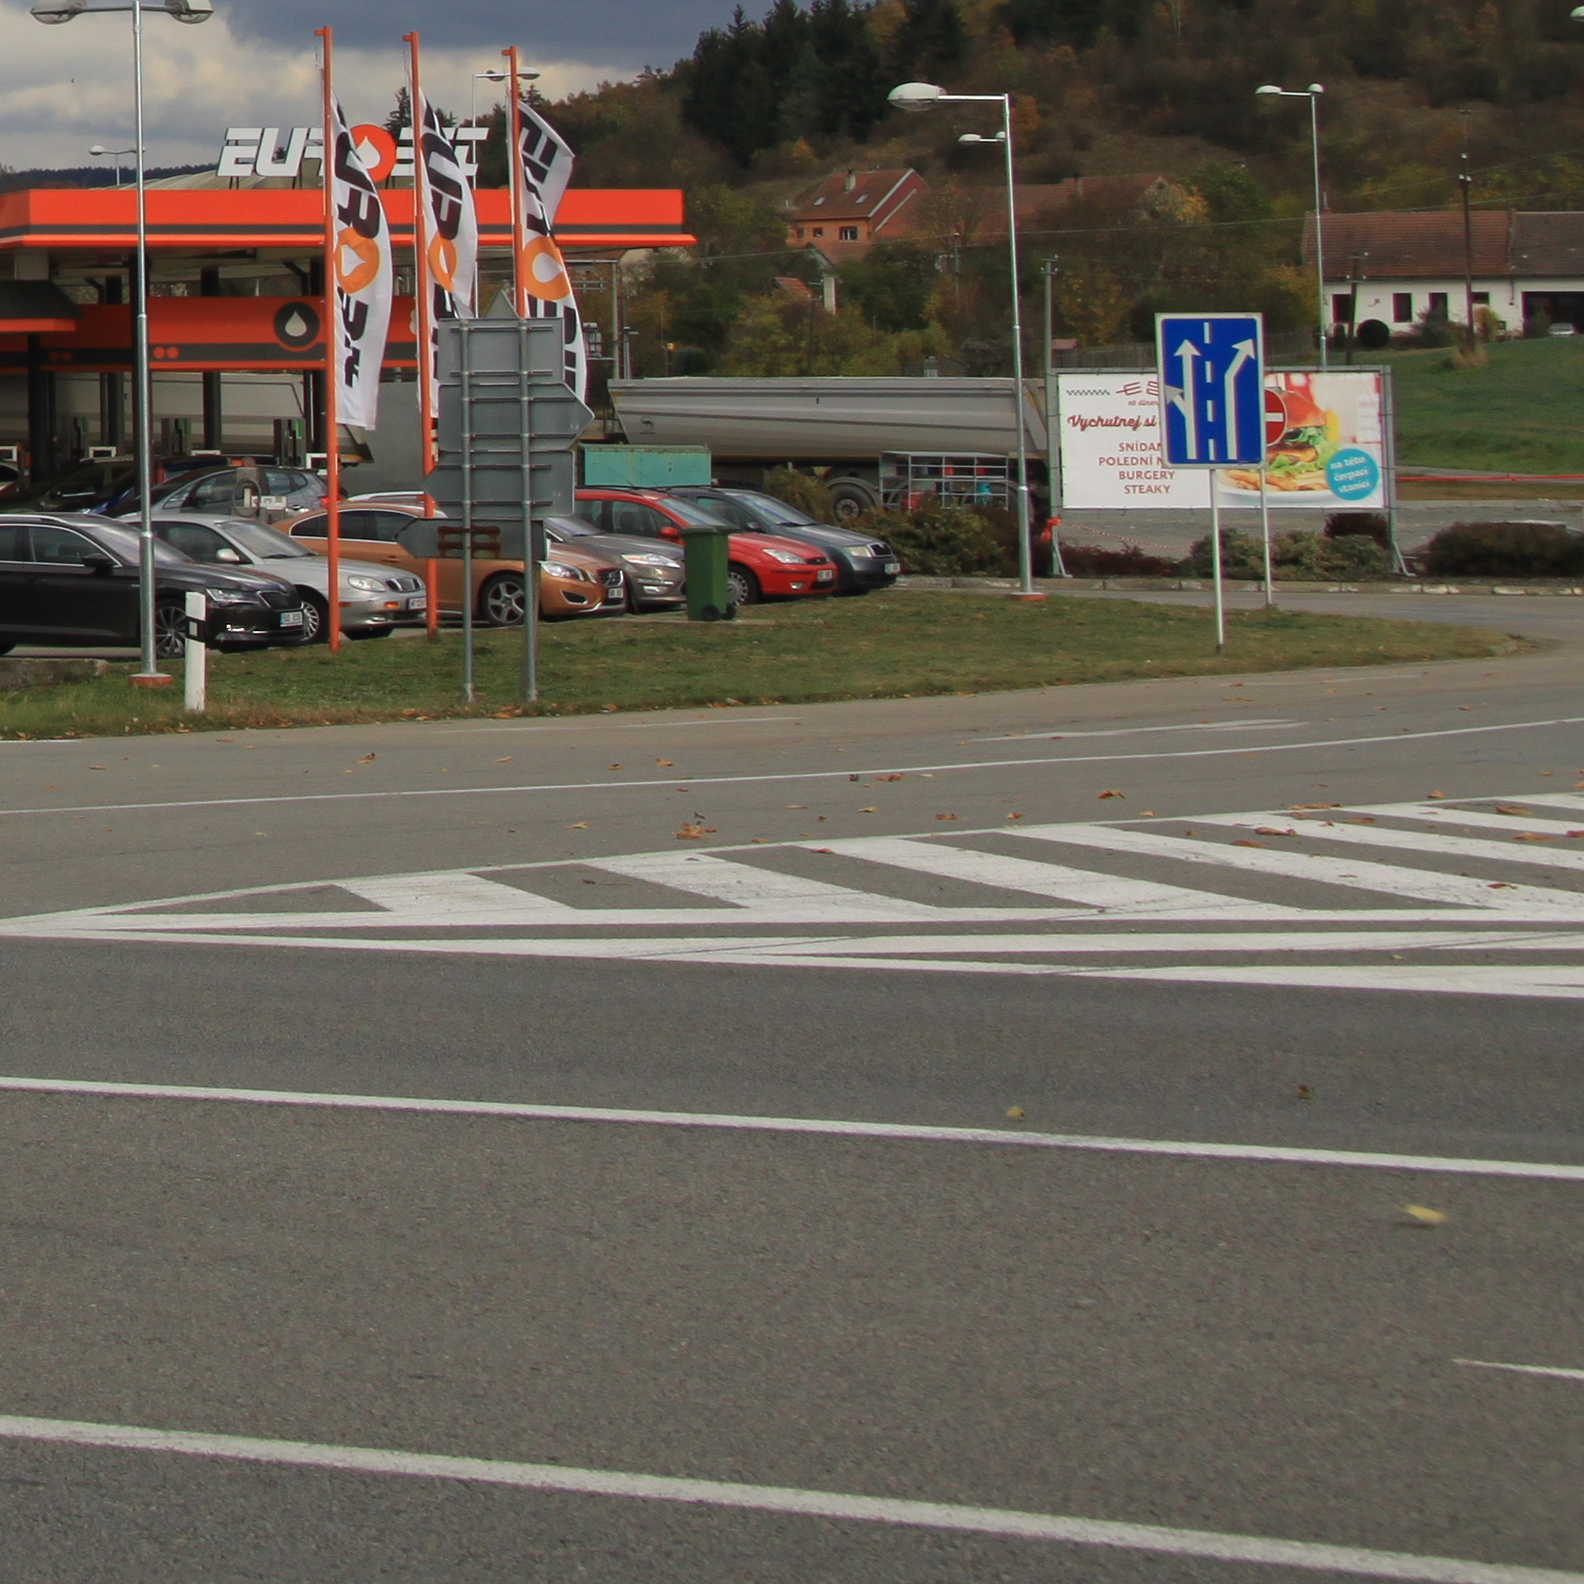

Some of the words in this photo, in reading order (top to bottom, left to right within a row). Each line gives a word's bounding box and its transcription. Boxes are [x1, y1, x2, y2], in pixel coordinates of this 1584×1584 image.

[1067, 414, 1141, 431] Vychutnej
[1143, 415, 1156, 427] si
[1098, 455, 1152, 466] POLEDNÍ
[1119, 471, 1175, 480] BURGERY
[1124, 485, 1171, 494] STEAKY
